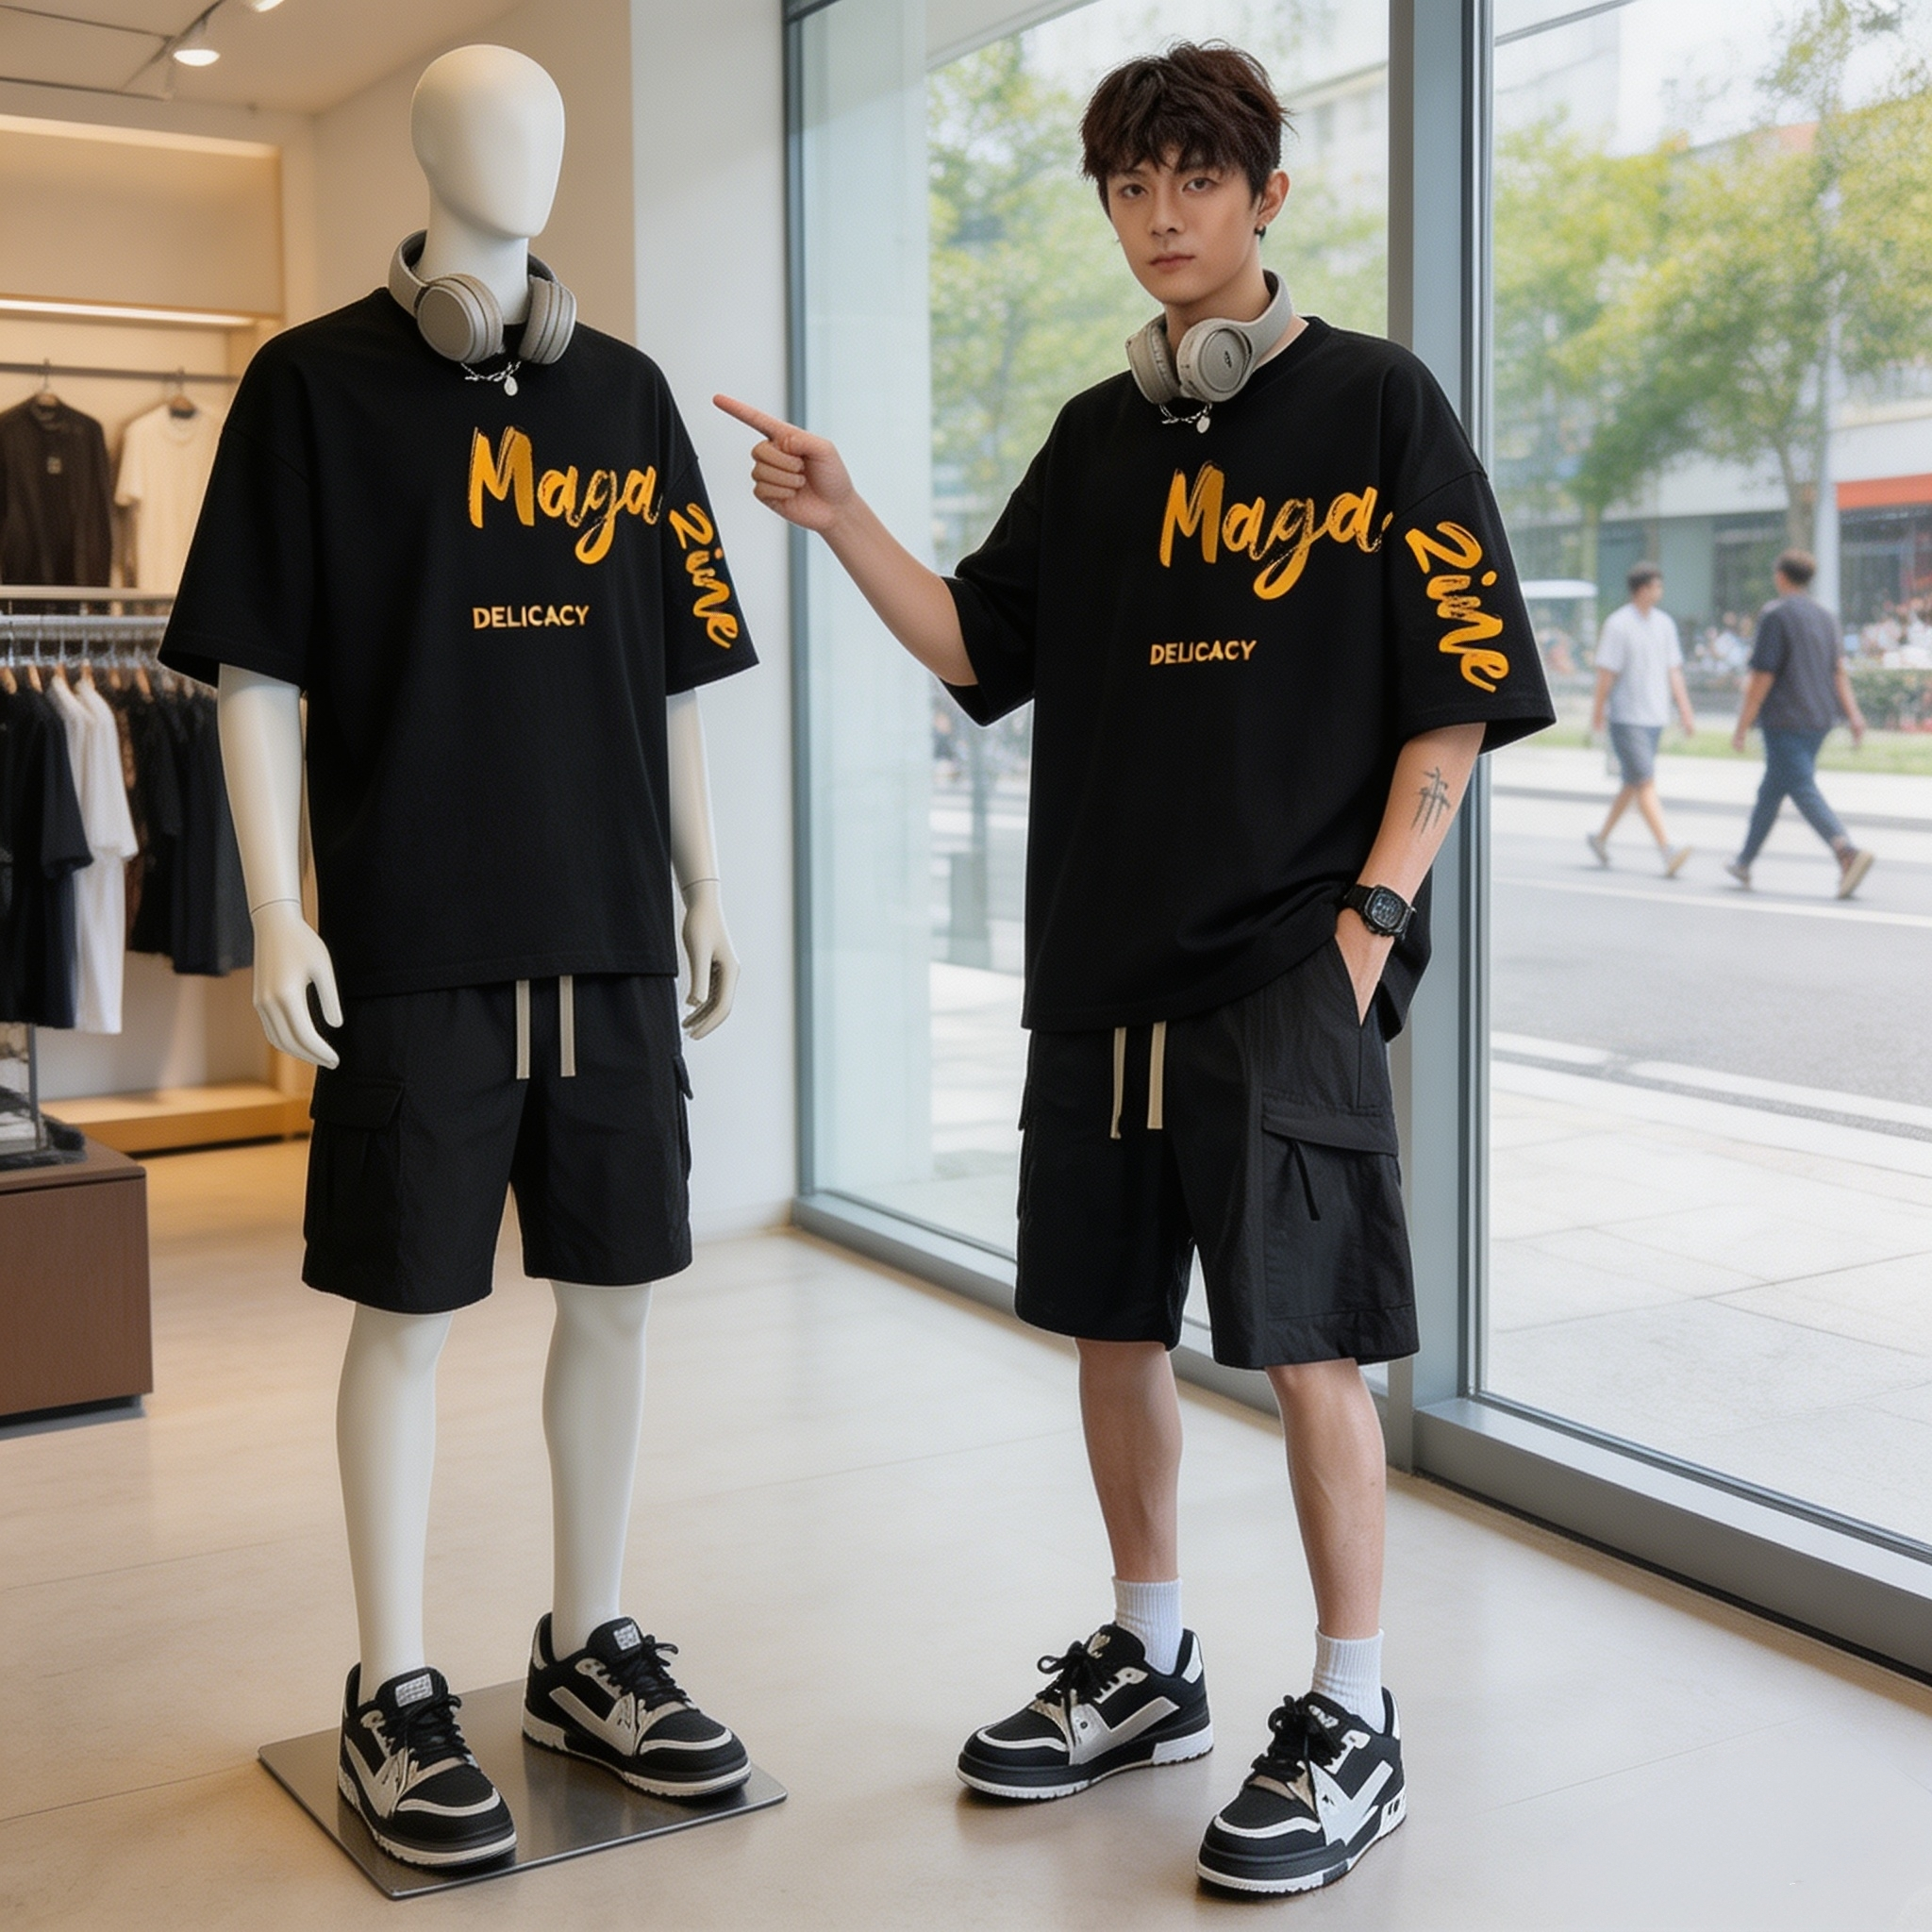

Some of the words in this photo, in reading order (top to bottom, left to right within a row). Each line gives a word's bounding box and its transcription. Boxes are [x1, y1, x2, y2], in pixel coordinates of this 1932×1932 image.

[469, 425, 663, 565] Maga
[1159, 460, 1393, 600] Maga
[474, 606, 589, 629] DELICACY
[1150, 641, 1257, 665] DELICACY
